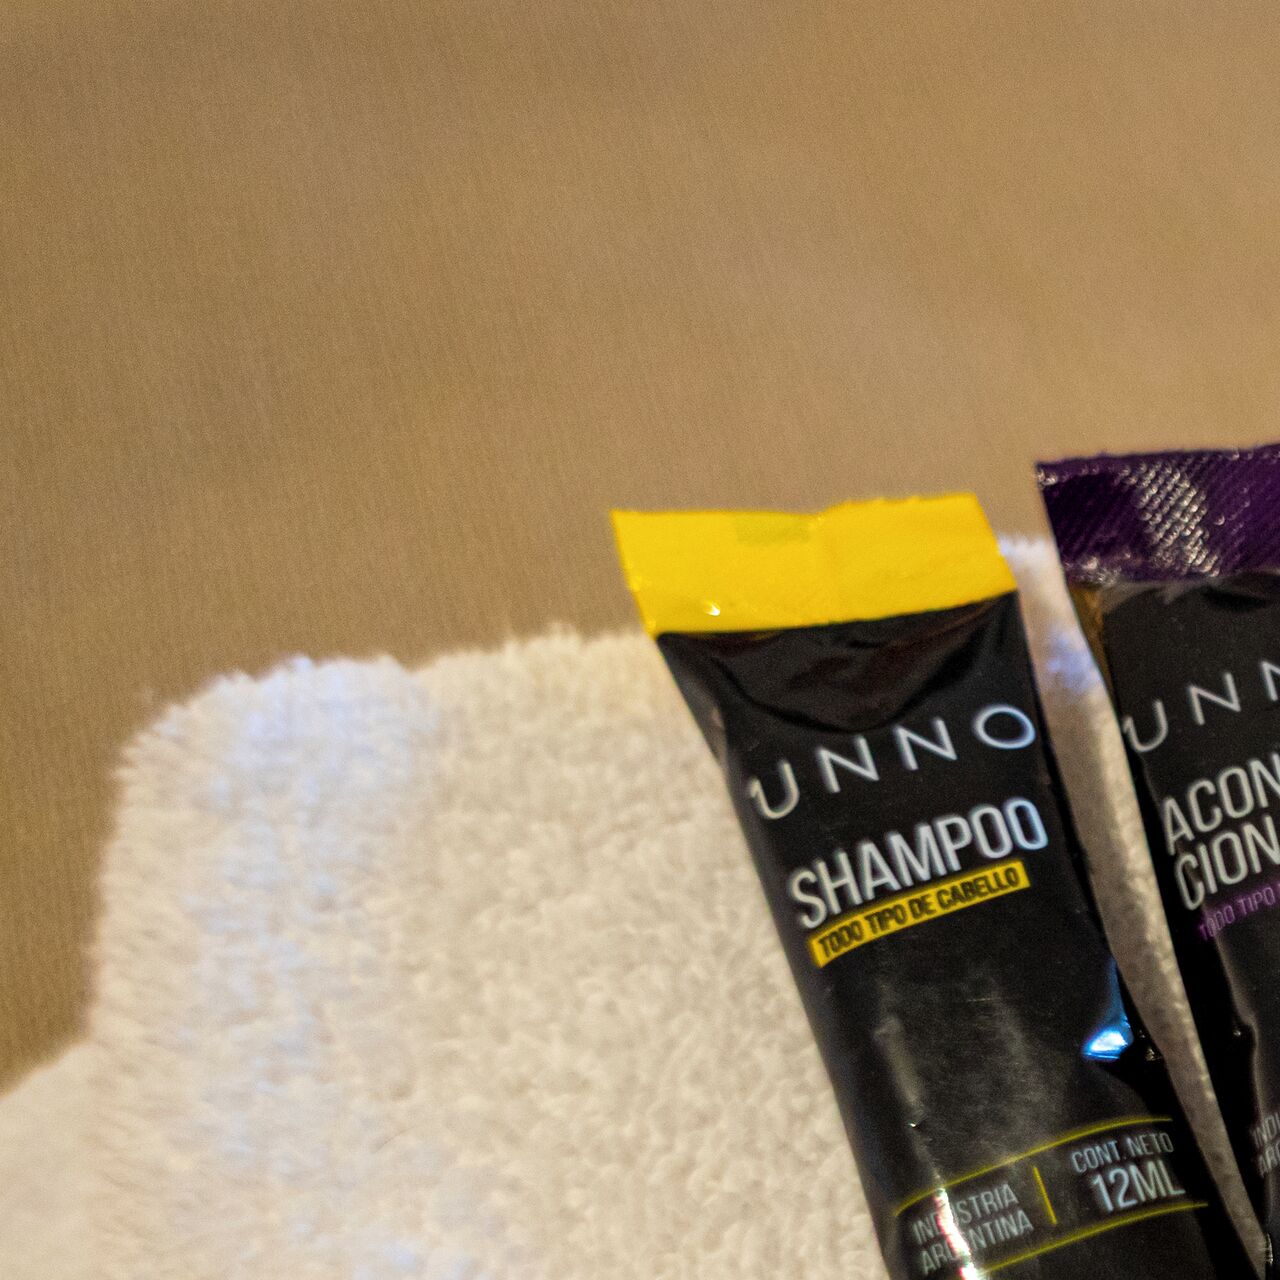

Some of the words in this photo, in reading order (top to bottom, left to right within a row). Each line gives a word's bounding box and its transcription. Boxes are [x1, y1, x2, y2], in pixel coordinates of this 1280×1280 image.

[749, 703, 1037, 820] UNNO
[788, 796, 1050, 930] SHAMPOO
[819, 920, 864, 957] TODO
[867, 903, 908, 929] TIPO
[910, 893, 936, 917] DE
[937, 867, 1021, 909] CABELLO
[1237, 887, 1275, 915] TIPO
[1128, 1131, 1175, 1158] NETO
[911, 1182, 1020, 1245] INDSTRIA
[1088, 1157, 1188, 1213] 12ML
[918, 1208, 1035, 1277] ARNTINA
